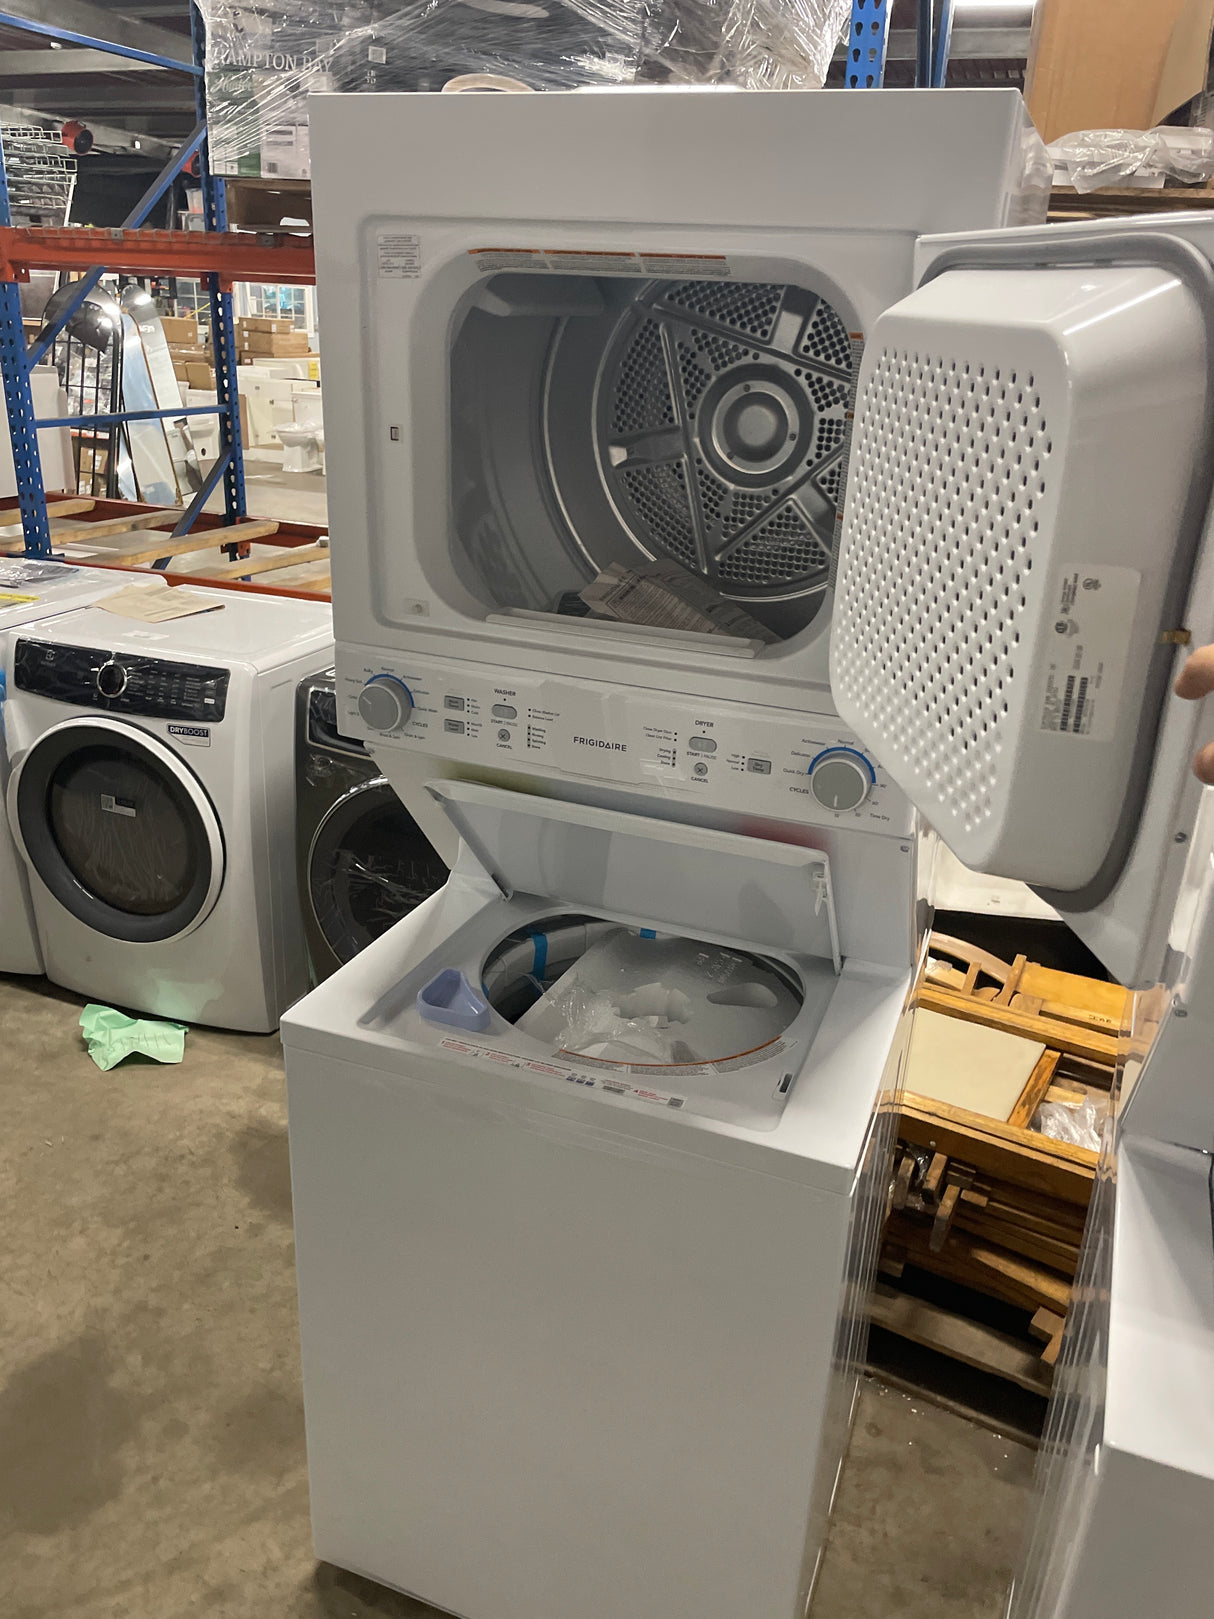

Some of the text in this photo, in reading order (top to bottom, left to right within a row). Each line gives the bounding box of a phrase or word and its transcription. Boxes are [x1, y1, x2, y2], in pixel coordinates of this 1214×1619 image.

[494, 688, 517, 697] WASHER
[695, 720, 714, 728] DRYER
[170, 726, 207, 736] DRYBOOST
[573, 736, 628, 752] FRIGIDAIRE
[789, 786, 809, 795] CYCLES
